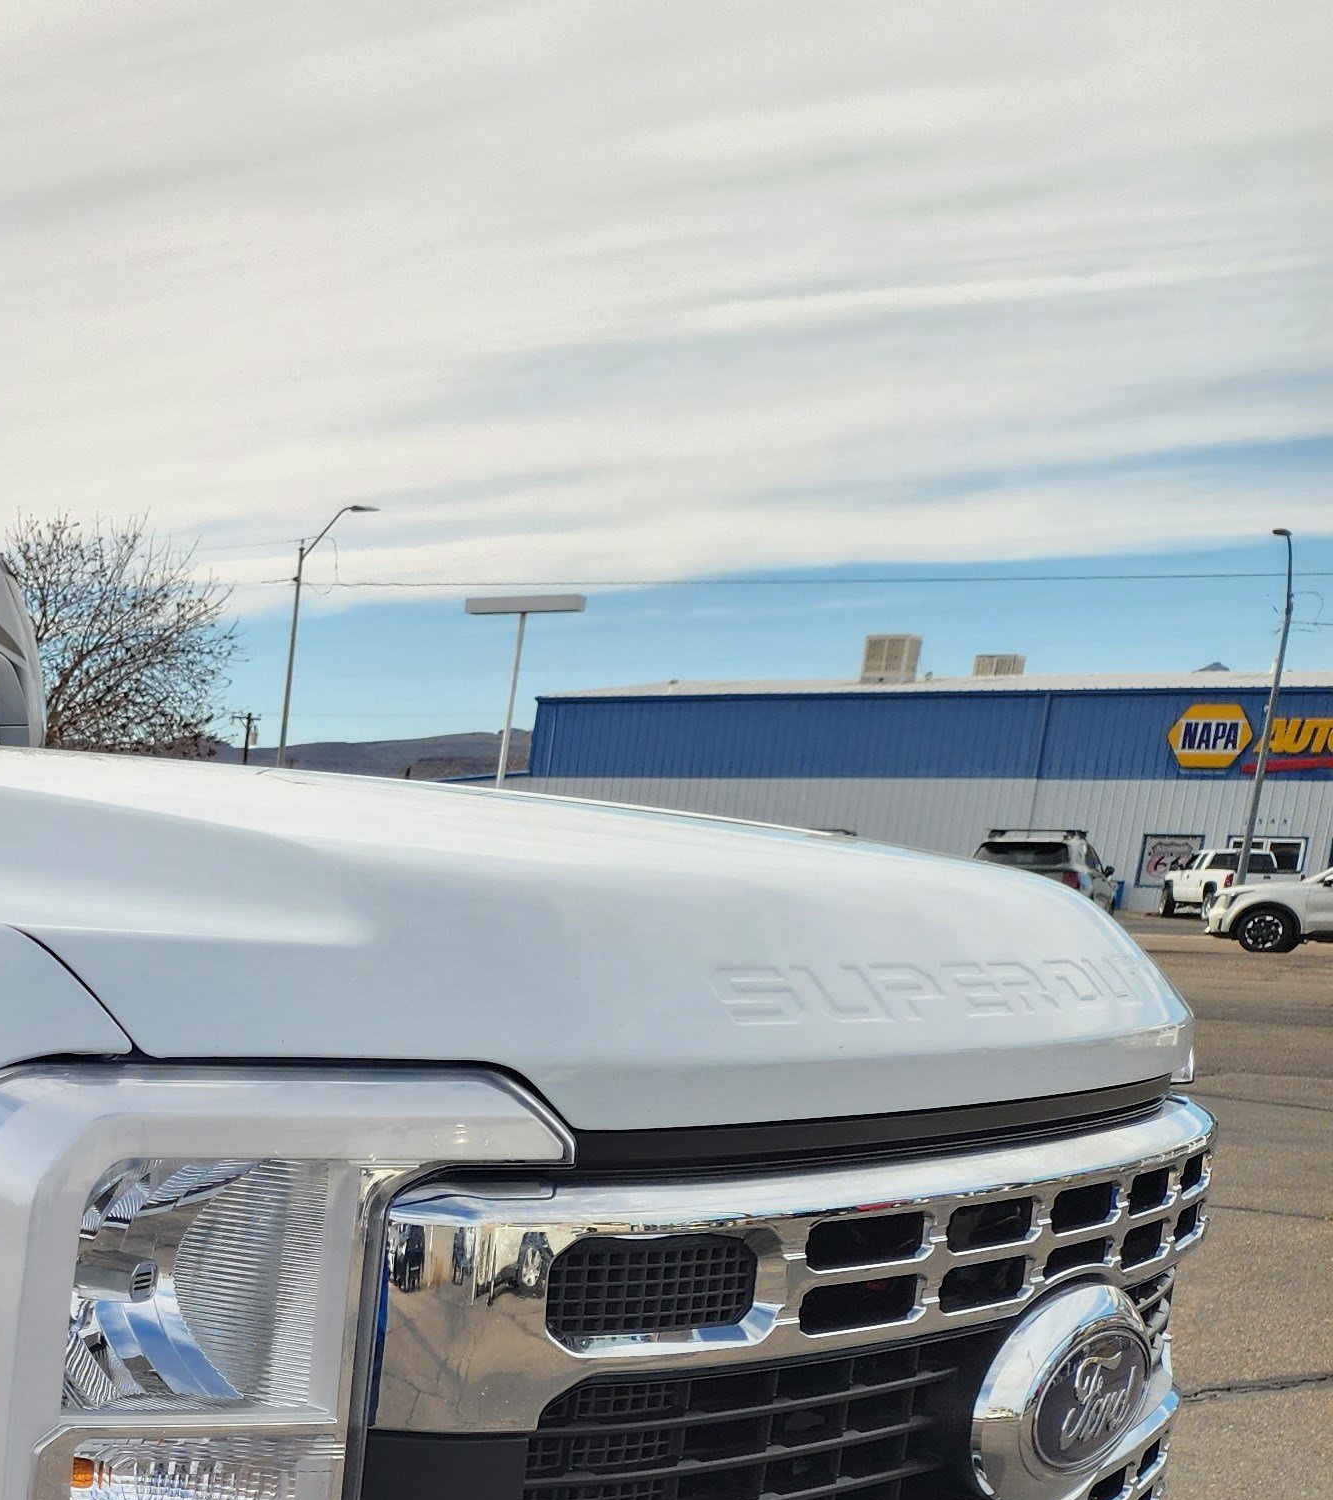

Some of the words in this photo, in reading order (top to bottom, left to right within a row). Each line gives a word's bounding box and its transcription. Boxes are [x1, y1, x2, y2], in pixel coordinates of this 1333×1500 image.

[1181, 721, 1240, 752] NAPA
[1253, 717, 1333, 755] AUT
[707, 957, 1065, 1026] SUPER
[1059, 1350, 1138, 1451] Ford
